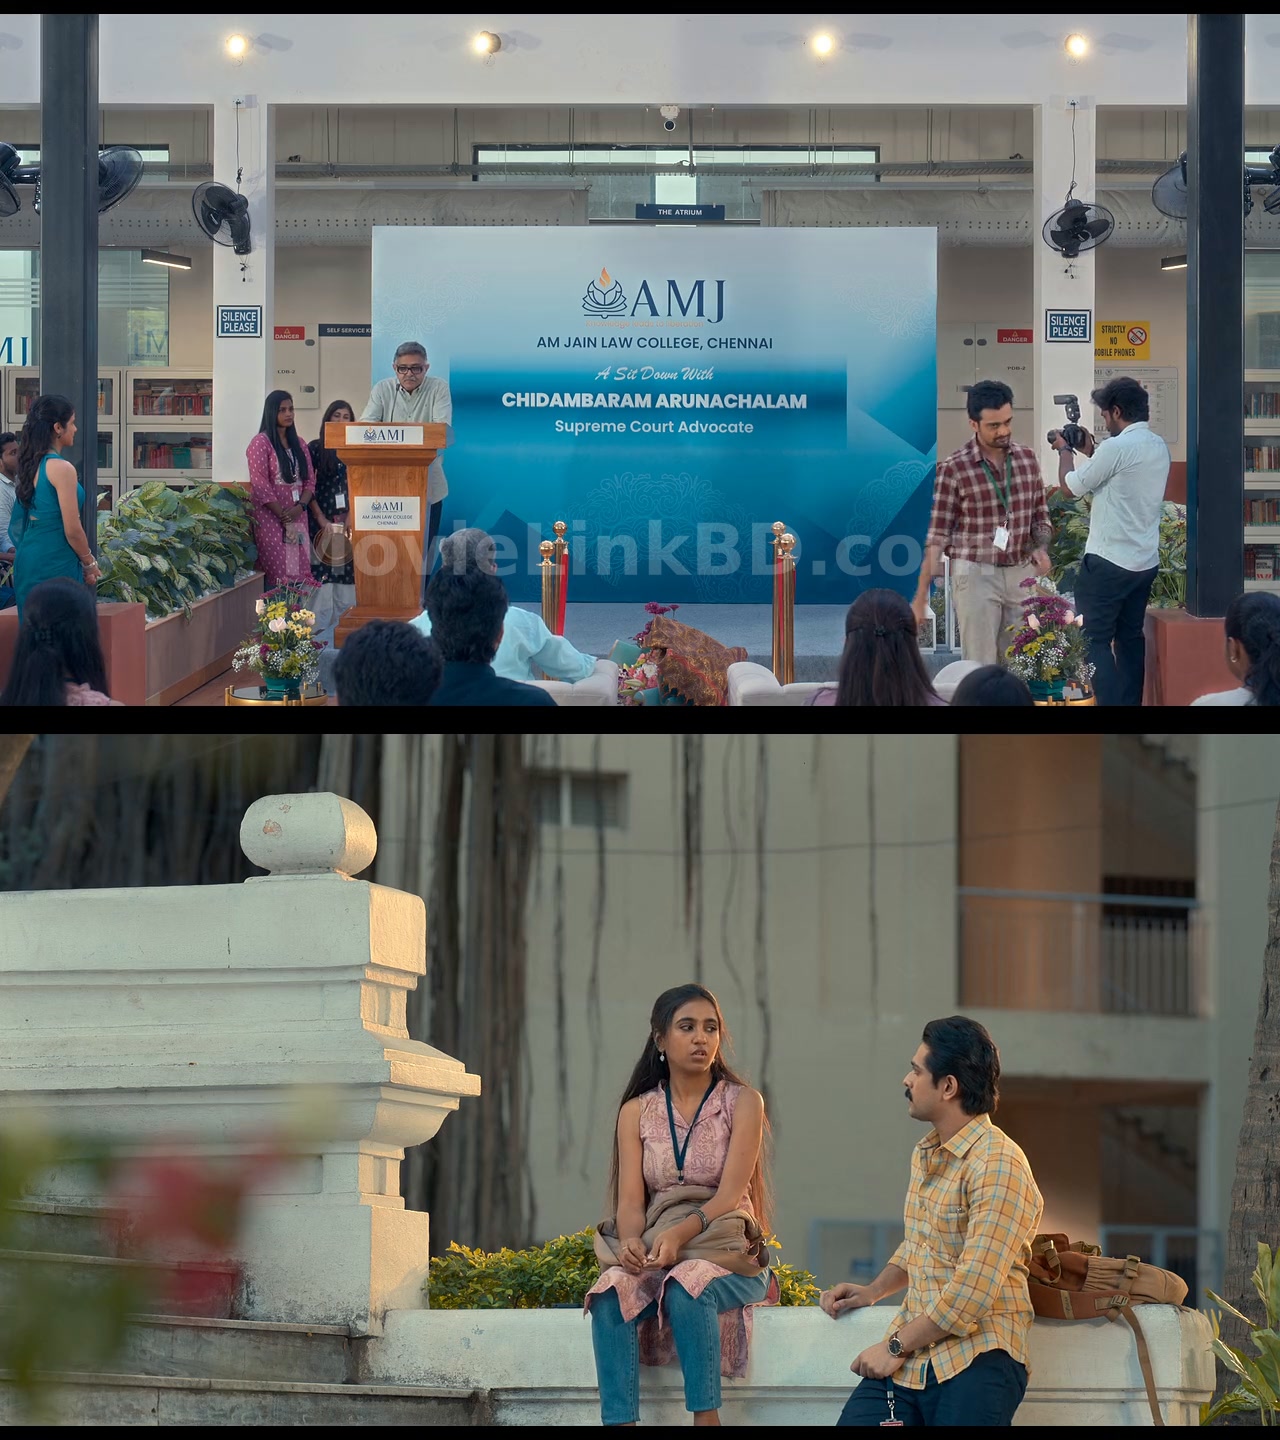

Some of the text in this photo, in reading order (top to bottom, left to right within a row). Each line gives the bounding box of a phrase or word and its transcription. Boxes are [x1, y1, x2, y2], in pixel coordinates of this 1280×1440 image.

[630, 279, 726, 323] AMJ
[222, 312, 256, 322] SILENCE
[1051, 316, 1085, 325] SILENCE
[224, 323, 255, 332] PLEASE
[1052, 327, 1084, 336] PLEASE
[1101, 325, 1126, 333] STRICTLY
[537, 337, 773, 350] AM JAIN LAW COLLEGE, CHENNAI
[1109, 337, 1117, 345] NO
[1114, 348, 1135, 356] PHONES
[595, 366, 714, 380] A Sit Down With
[502, 392, 807, 409] CHIDAMBARAM ARUNACHALAM
[555, 420, 754, 436] Supreme Court Advocate
[377, 429, 404, 442] AMJ
[381, 502, 403, 512] AMJ
